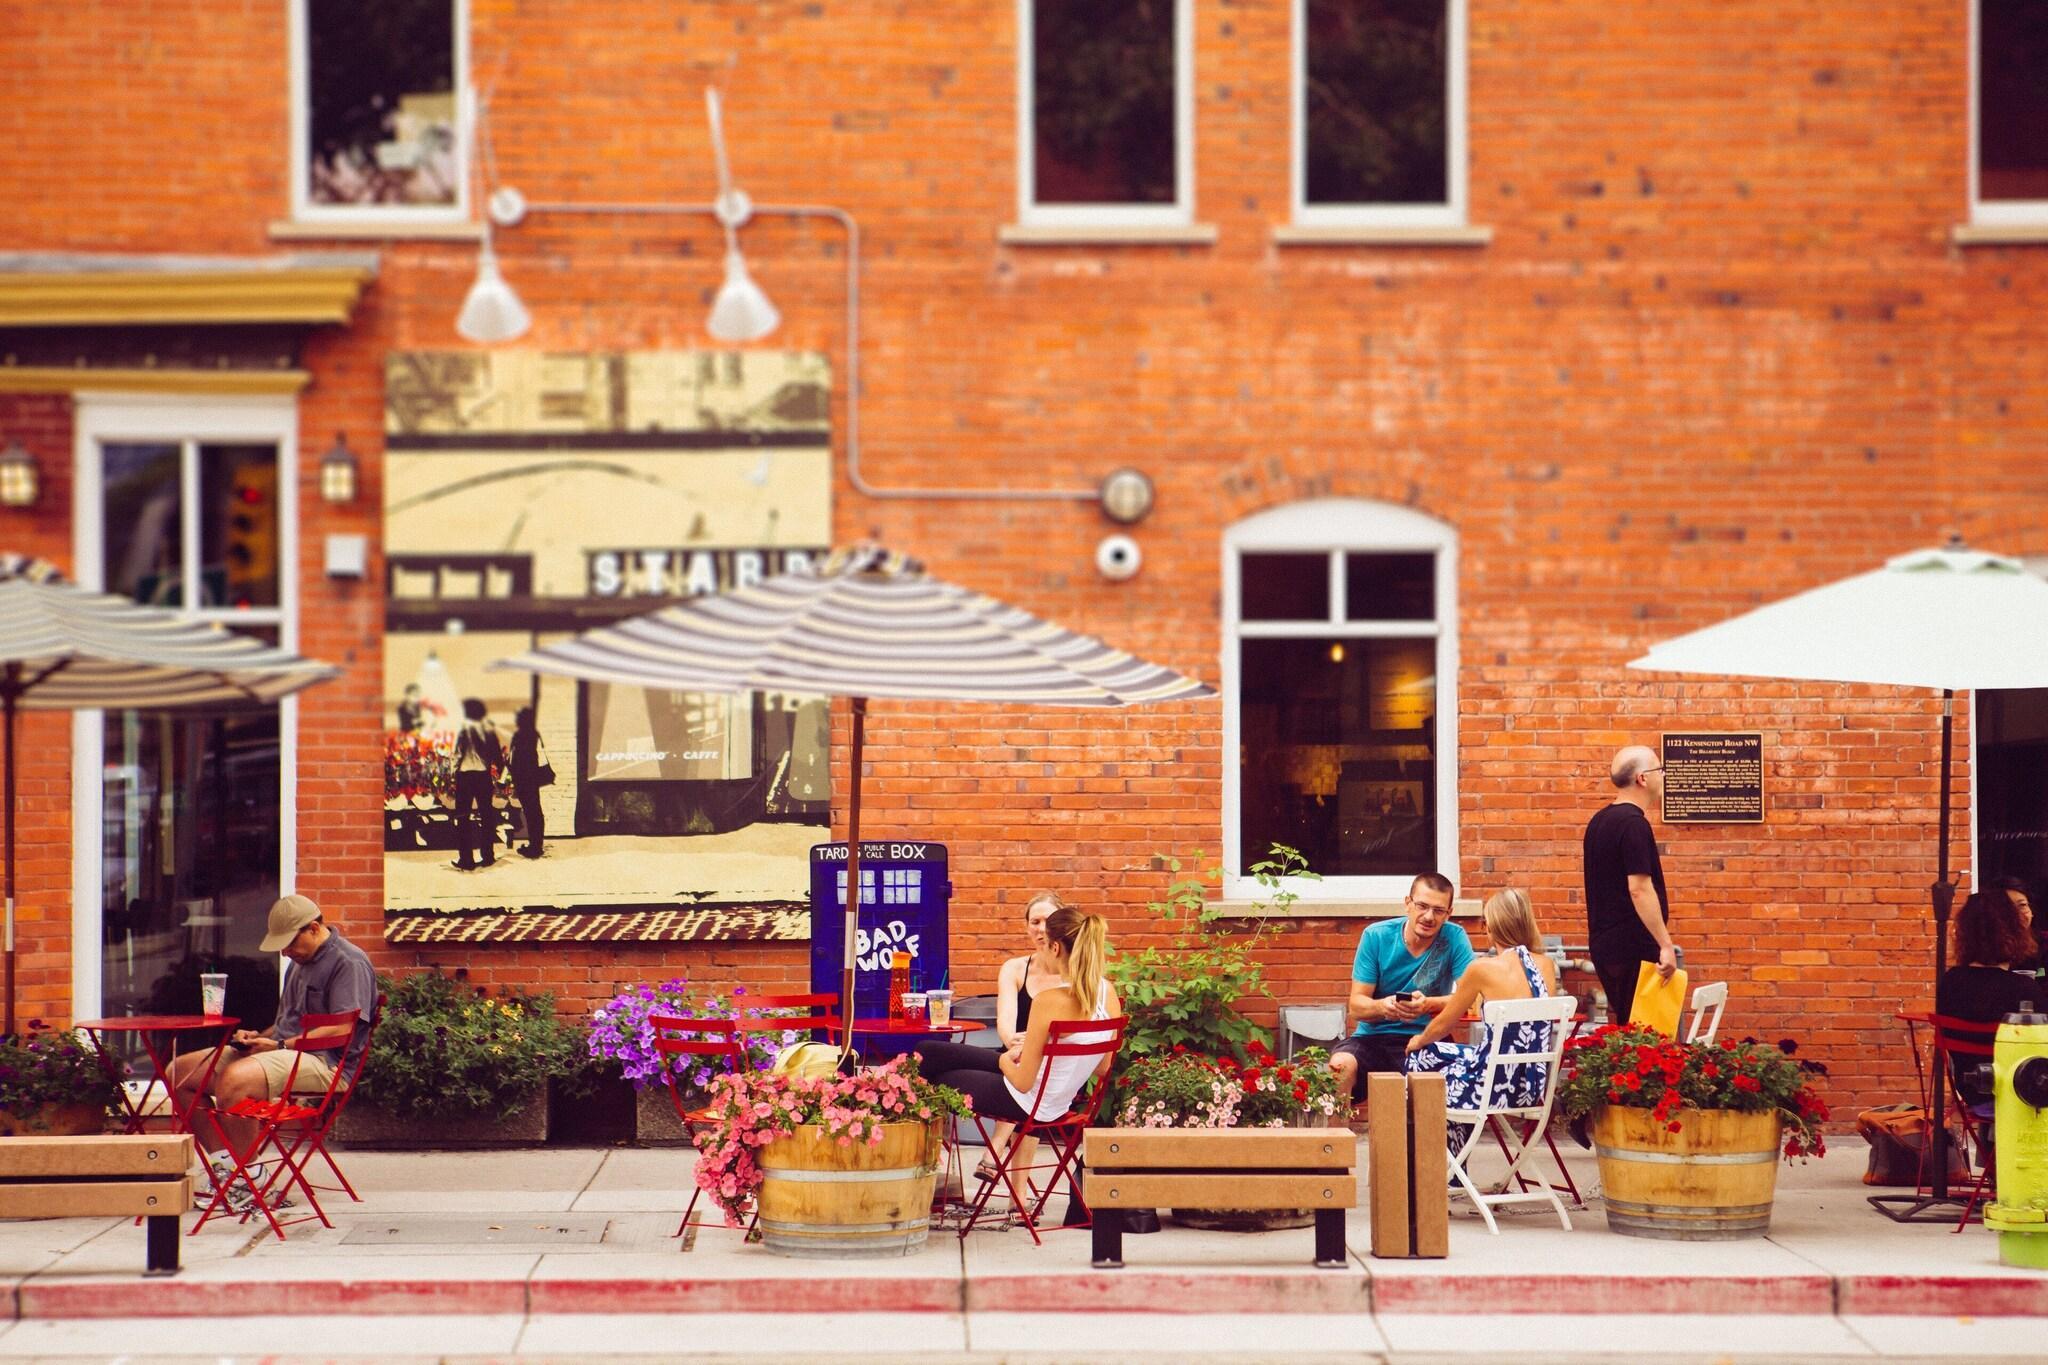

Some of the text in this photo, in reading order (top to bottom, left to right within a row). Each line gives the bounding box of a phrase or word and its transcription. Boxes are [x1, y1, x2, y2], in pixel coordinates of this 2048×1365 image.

[1667, 739, 1758, 747] 1122 KENSINGTON ROAD NW
[816, 847, 861, 860] TARD
[866, 851, 883, 859] CALL
[891, 844, 926, 859] BOX
[856, 921, 906, 956] BAD
